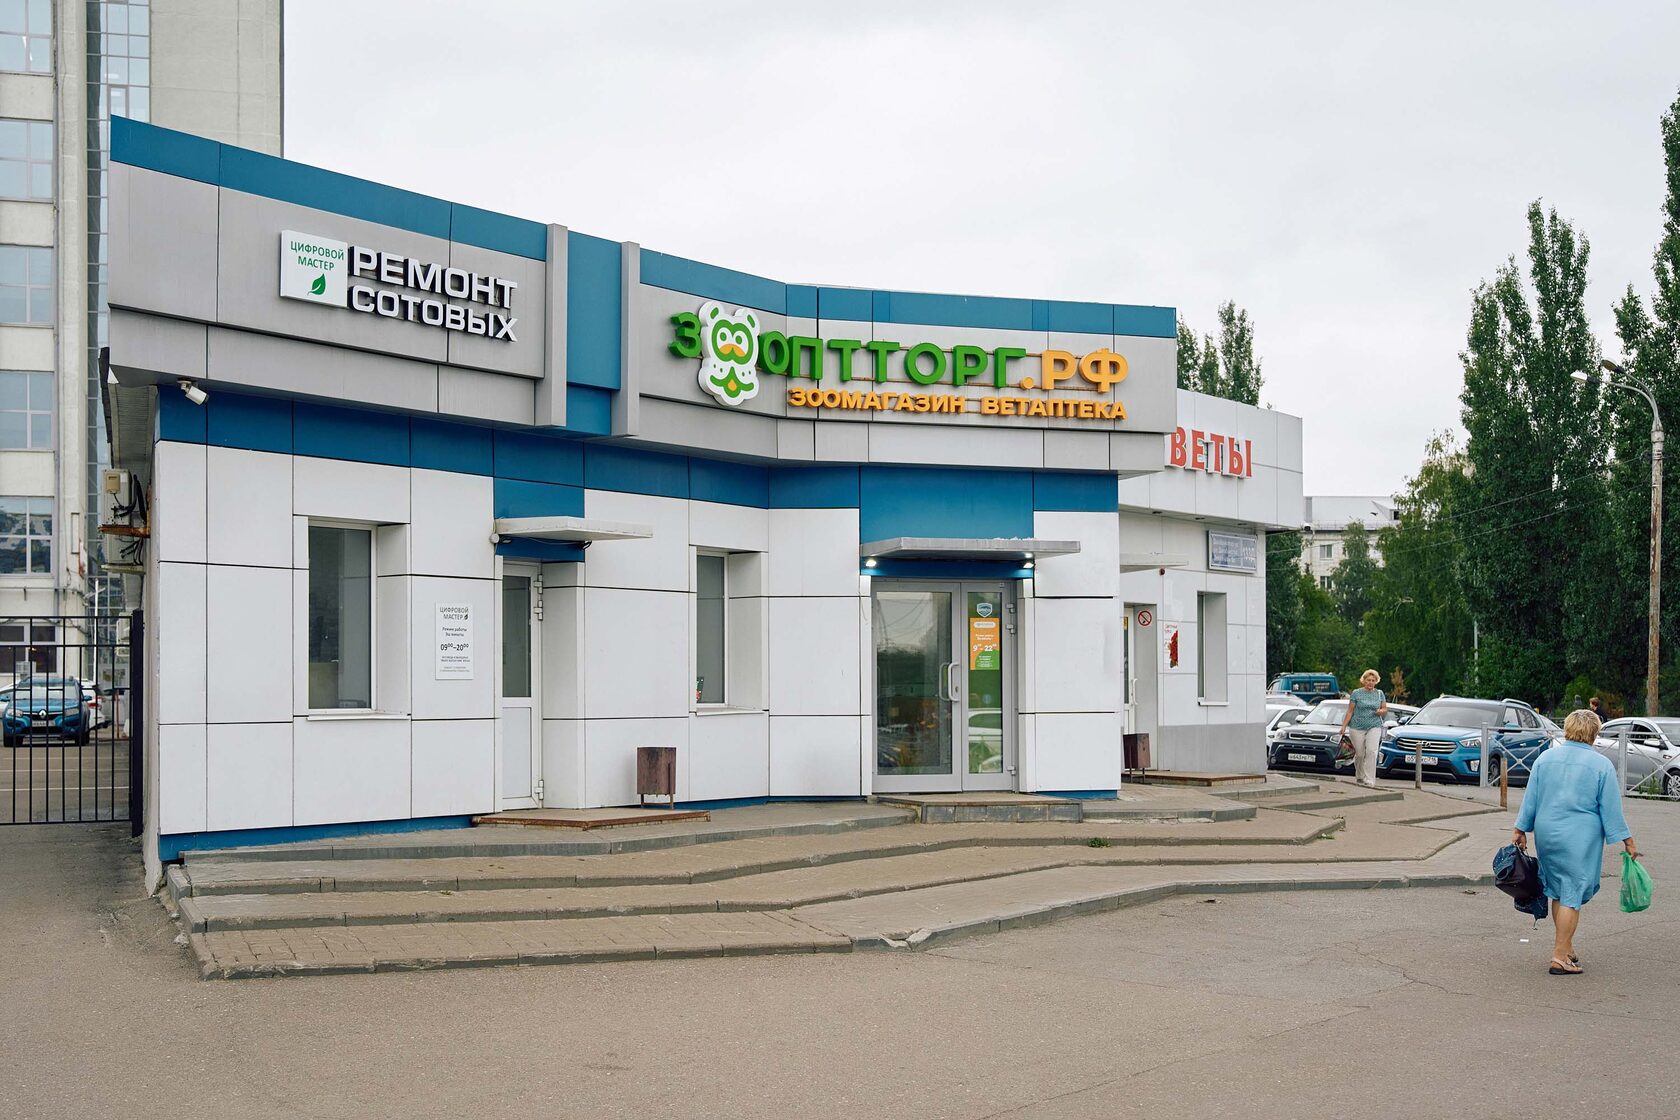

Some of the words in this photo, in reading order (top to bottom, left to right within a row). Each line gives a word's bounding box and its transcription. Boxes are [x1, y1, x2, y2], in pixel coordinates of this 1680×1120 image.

[290, 240, 344, 261] ЦИФРОВОЙ
[297, 255, 335, 271] МАСТЕР
[352, 245, 518, 308] РЕМОНТ
[351, 284, 518, 342] СОТОВЫХ
[788, 387, 966, 413] ЗООМАГАЗИН
[980, 396, 1128, 419] ВЕТАПТЕКА
